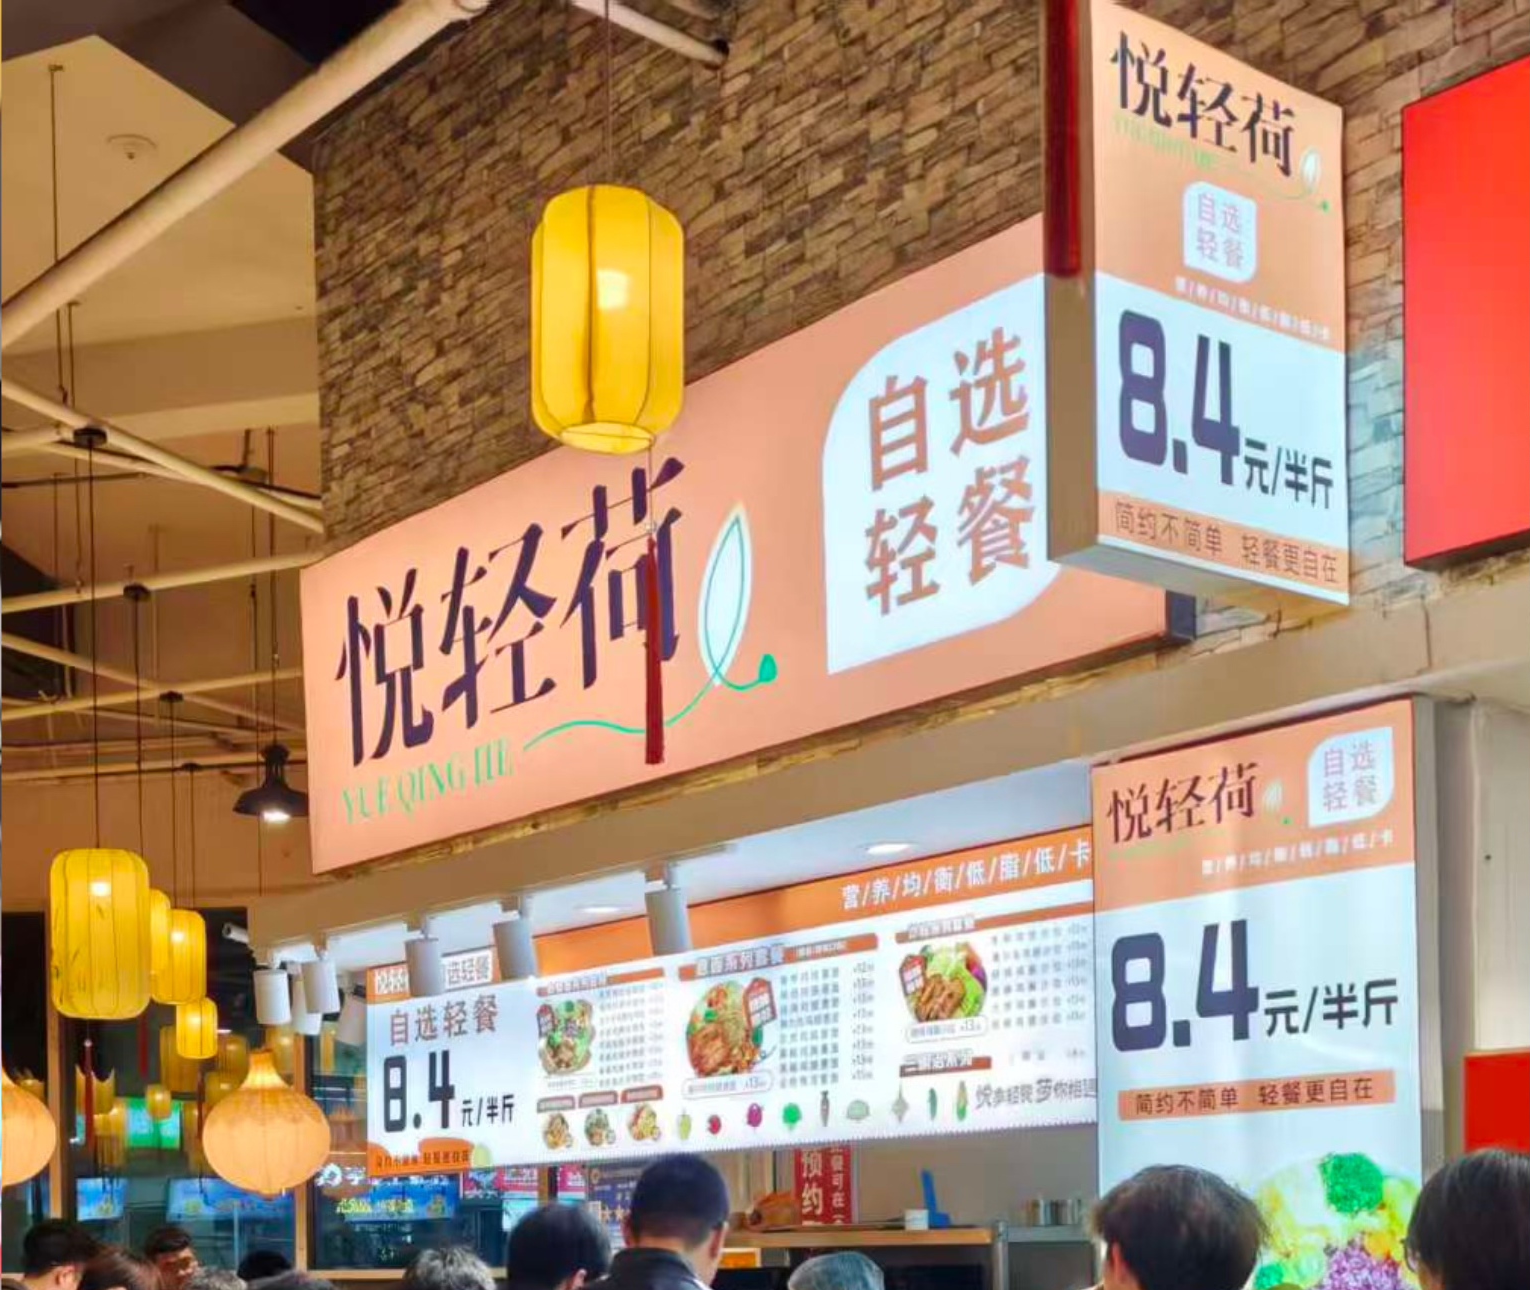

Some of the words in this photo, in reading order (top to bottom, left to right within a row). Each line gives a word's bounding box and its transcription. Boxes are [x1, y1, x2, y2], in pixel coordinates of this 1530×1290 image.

[1111, 31, 1296, 178] 悦轻荷
[865, 326, 1031, 493] 自选
[1118, 308, 1335, 509] 8.4元/半斤
[863, 456, 1037, 615] 轻餐
[1114, 500, 1223, 557] 简约不简单
[1241, 533, 1338, 584] 轻餐更自在
[335, 456, 686, 767] 悦轻荷
[1106, 762, 1259, 845] 悦轻荷
[841, 838, 1091, 911] 营/养/均/衡/低/脂/低/卡
[388, 994, 499, 1046] 自选轻餐
[1111, 918, 1399, 1052] 8.4元/半斤
[1134, 1086, 1240, 1116] 简约不简单
[1257, 1077, 1373, 1107] 轻餐更自在
[800, 1148, 824, 1226] 预约
